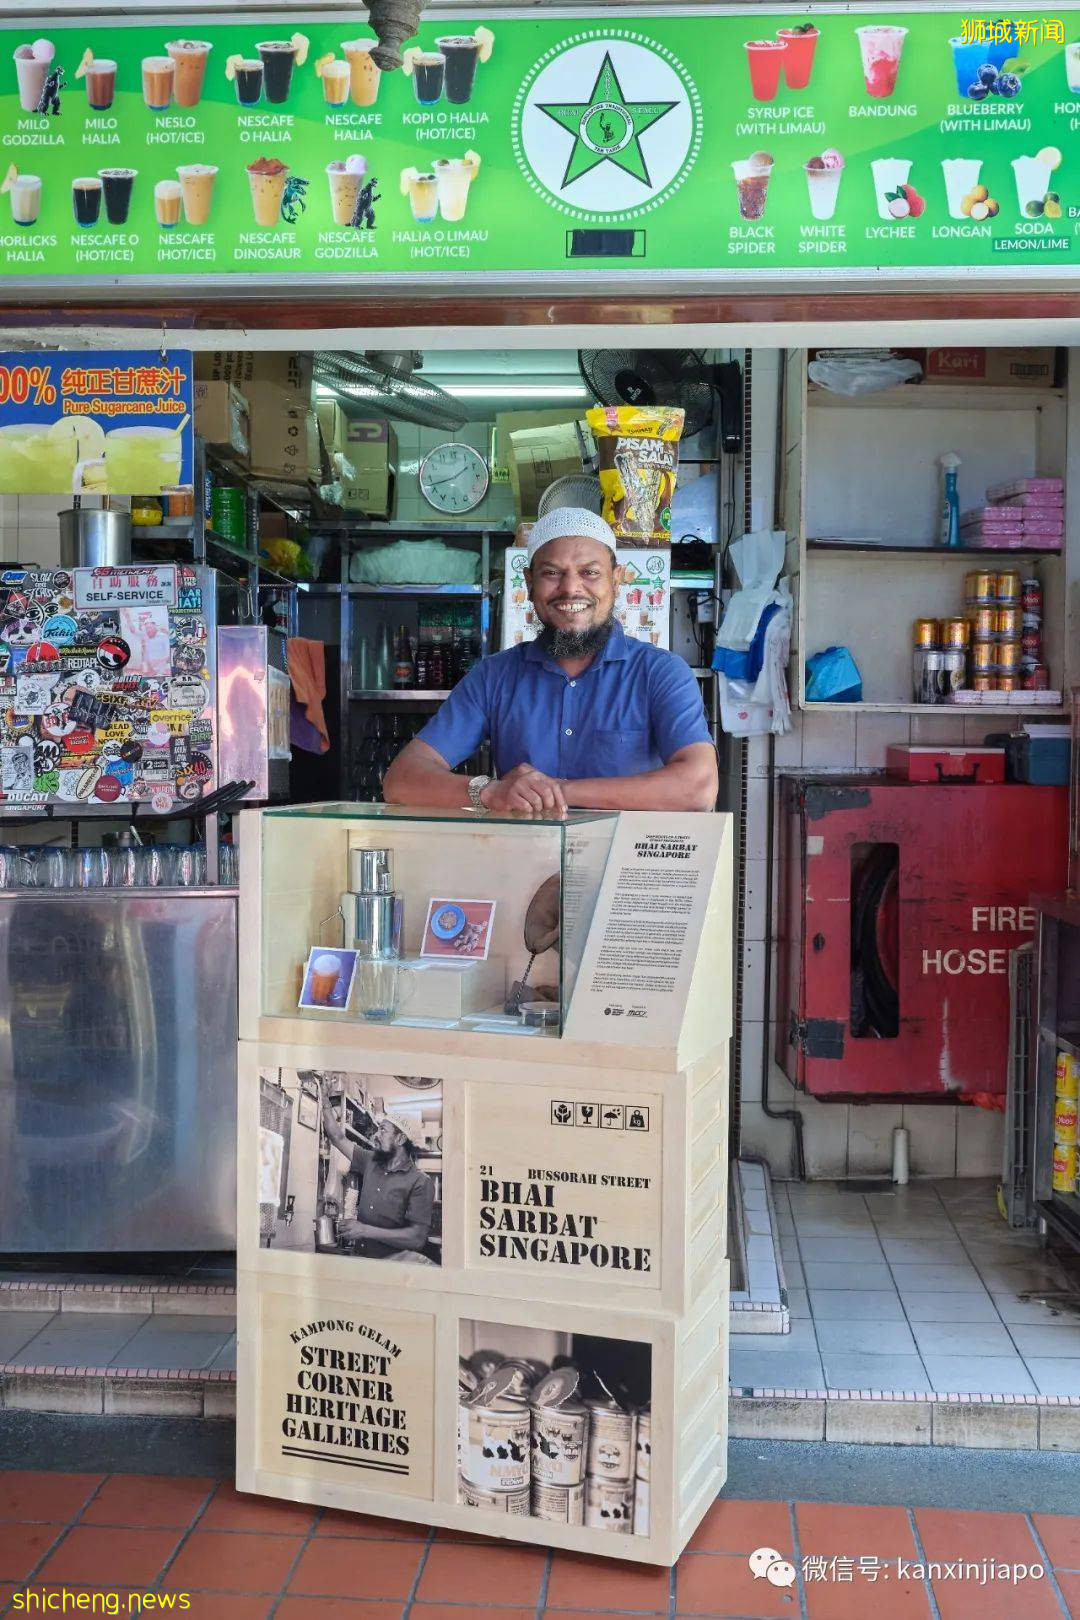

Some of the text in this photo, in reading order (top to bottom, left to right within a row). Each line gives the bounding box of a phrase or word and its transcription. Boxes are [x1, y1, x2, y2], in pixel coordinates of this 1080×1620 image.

[747, 106, 814, 119] SYRUP ICE
[847, 104, 918, 118] BANDUNG
[946, 103, 1024, 116] BLUEBERRY
[17, 119, 50, 130] MILO
[85, 118, 118, 129] MILO
[155, 116, 196, 129] NESLO
[237, 115, 295, 127] NESCAFE
[325, 113, 382, 126] NESCAFE
[402, 111, 489, 125] KOPI O HALIA
[939, 117, 1032, 132] (WITH LIMAU)
[415, 127, 476, 141] (HOT/ICE)
[735, 121, 826, 135] (WITH LIMAU)
[2, 134, 65, 146] GODZILLA
[82, 133, 121, 145] HALIA
[146, 131, 205, 145] (HOT/ICE)
[239, 130, 292, 143] O HALIA
[333, 129, 374, 142] HALIA
[729, 226, 774, 239] BLACK
[799, 224, 846, 237] WHITE
[865, 226, 916, 239] LYCHEE
[932, 225, 992, 238] LONGAN
[1014, 222, 1055, 235] SODA
[70, 234, 140, 246] NESCAFE O
[158, 233, 215, 245] NESCAFE
[239, 231, 297, 244] NESCAFE
[318, 231, 376, 243] NESCAFE
[391, 230, 489, 243] HALIA O LIMAU
[727, 241, 776, 254] SPIDER
[798, 240, 847, 253] SPIDER
[994, 238, 1069, 250] LEMON/LIME
[6, 250, 45, 262] HALIA
[75, 249, 134, 263] (HOT/ICE)
[157, 248, 217, 262] (HOT/ICE)
[233, 247, 302, 260] DINOSAUR
[314, 246, 379, 259] GODZILLA
[410, 245, 471, 259] (HOT/ICE)
[61, 367, 186, 395] 纯正甘蔗汁
[63, 399, 185, 416] Pure Sugarcane Juice
[86, 590, 164, 602] SELF-SERVICE
[7, 792, 49, 803] DUCATI
[634, 842, 698, 852] BHAI SARBAT
[636, 850, 691, 859] SINGAPORE
[972, 906, 1036, 932] FIRE
[922, 948, 1007, 975] HOSE
[479, 1164, 651, 1189] 21 BUSSORAH STREET
[480, 1179, 555, 1208] BHAI
[479, 1206, 598, 1239] SARBAT
[479, 1233, 651, 1272] SINGAPORE
[289, 1319, 402, 1359] KAMPONG GELAM
[300, 1345, 391, 1377] STREET
[297, 1370, 394, 1403] CORNER
[286, 1392, 407, 1430] HERITAGE
[282, 1417, 410, 1456] GALLERIES
